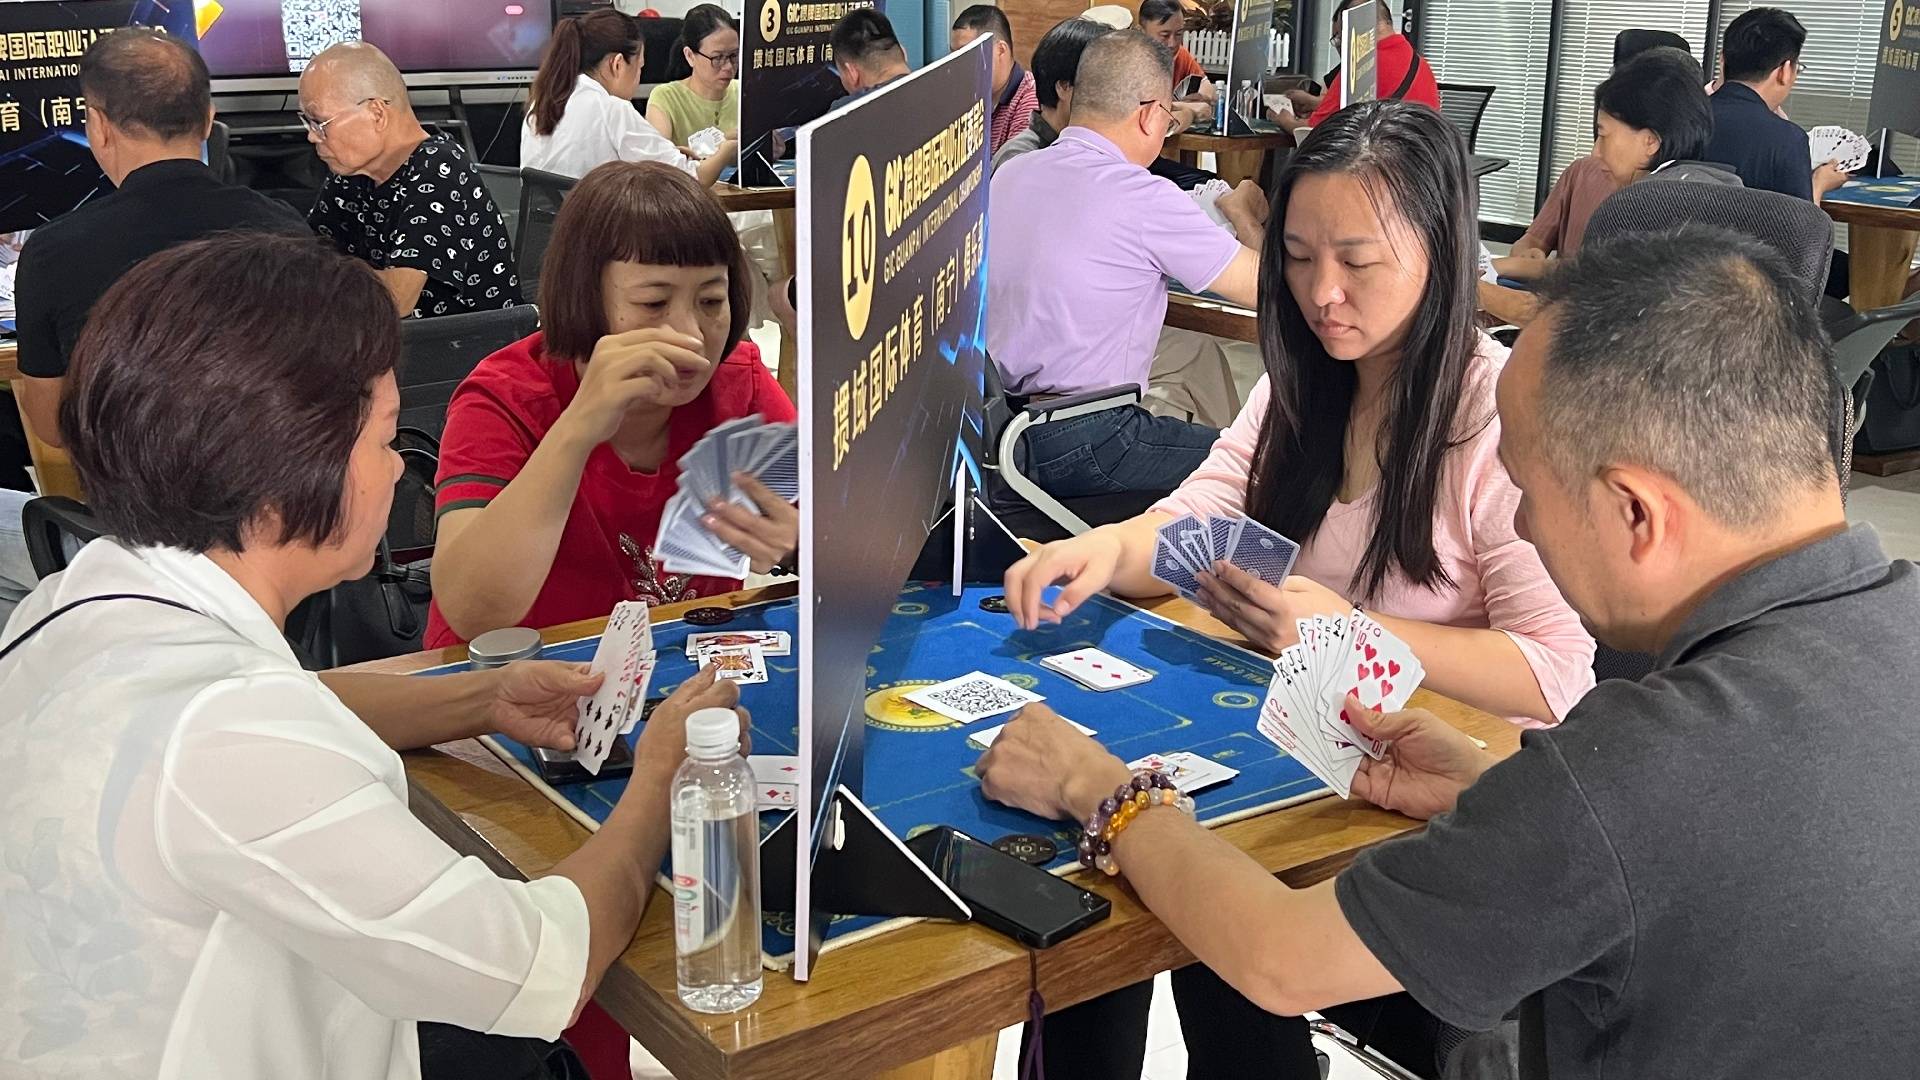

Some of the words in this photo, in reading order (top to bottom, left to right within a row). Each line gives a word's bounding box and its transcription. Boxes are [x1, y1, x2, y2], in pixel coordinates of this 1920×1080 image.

[766, 8, 775, 32] 3
[1892, 8, 1900, 31] 5
[14, 63, 81, 81] INTERNATIO
[848, 200, 872, 302] 10
[1356, 630, 1367, 645] 10
[1287, 651, 1295, 666] J
[1277, 662, 1290, 678] K
[1269, 698, 1283, 712] 2
[1372, 739, 1384, 756] 10
